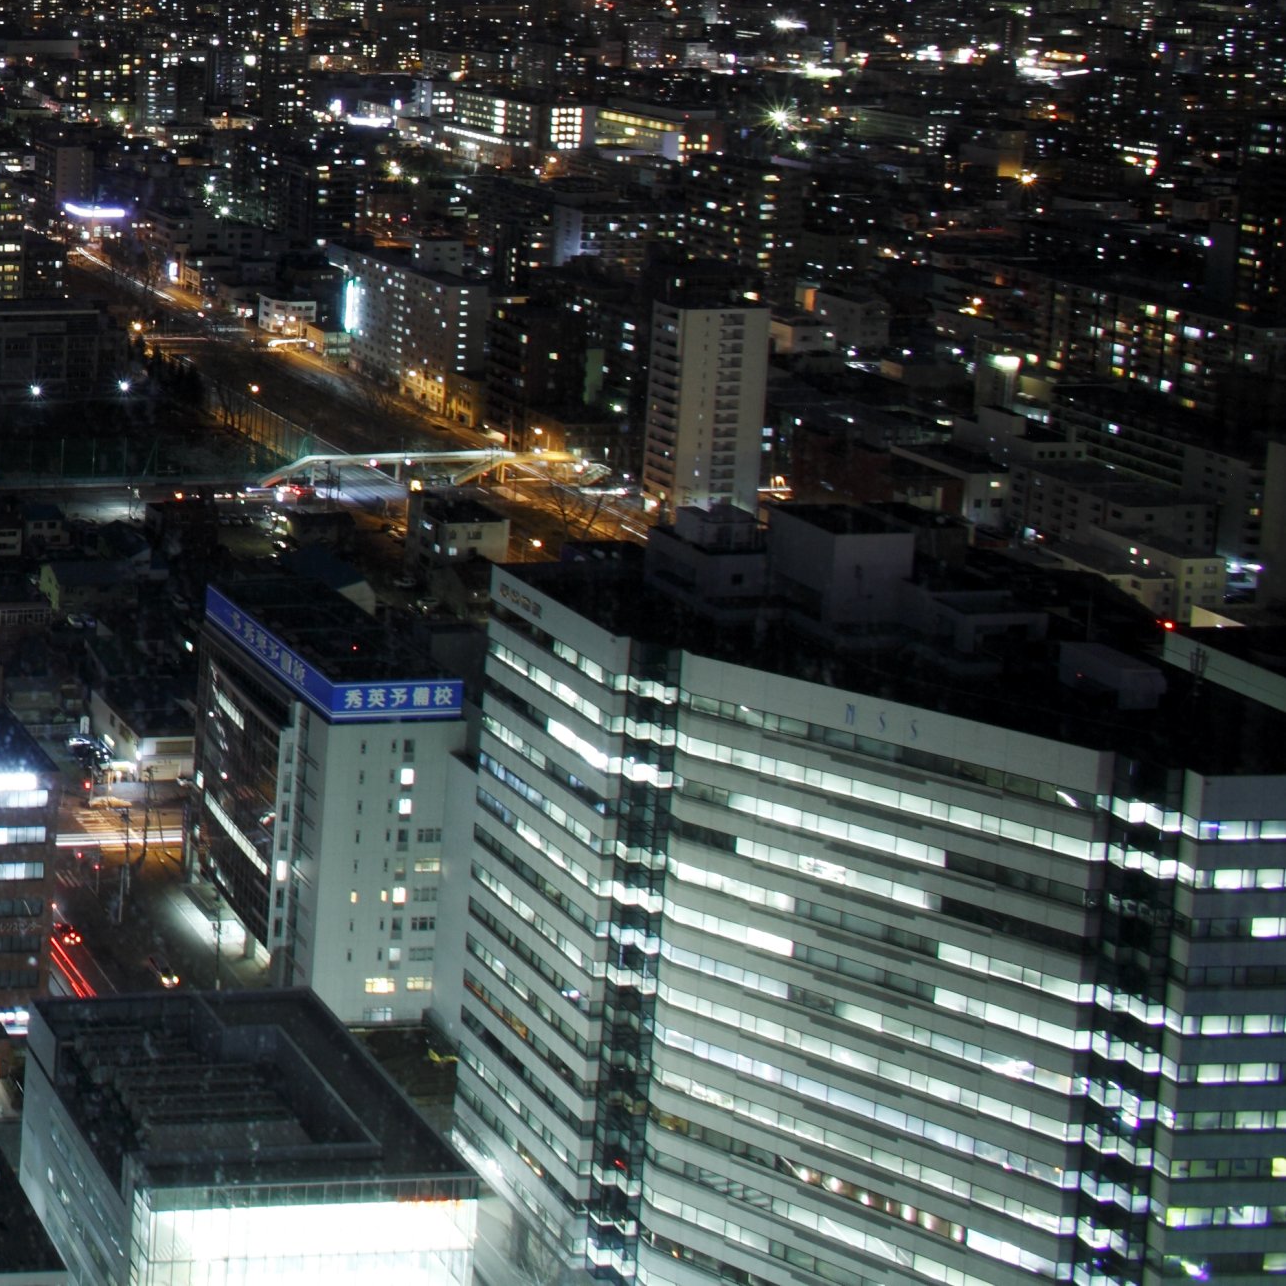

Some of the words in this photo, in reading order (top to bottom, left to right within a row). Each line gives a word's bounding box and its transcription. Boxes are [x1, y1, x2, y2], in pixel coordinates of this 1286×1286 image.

[344, 686, 454, 710] 秀英予備校
